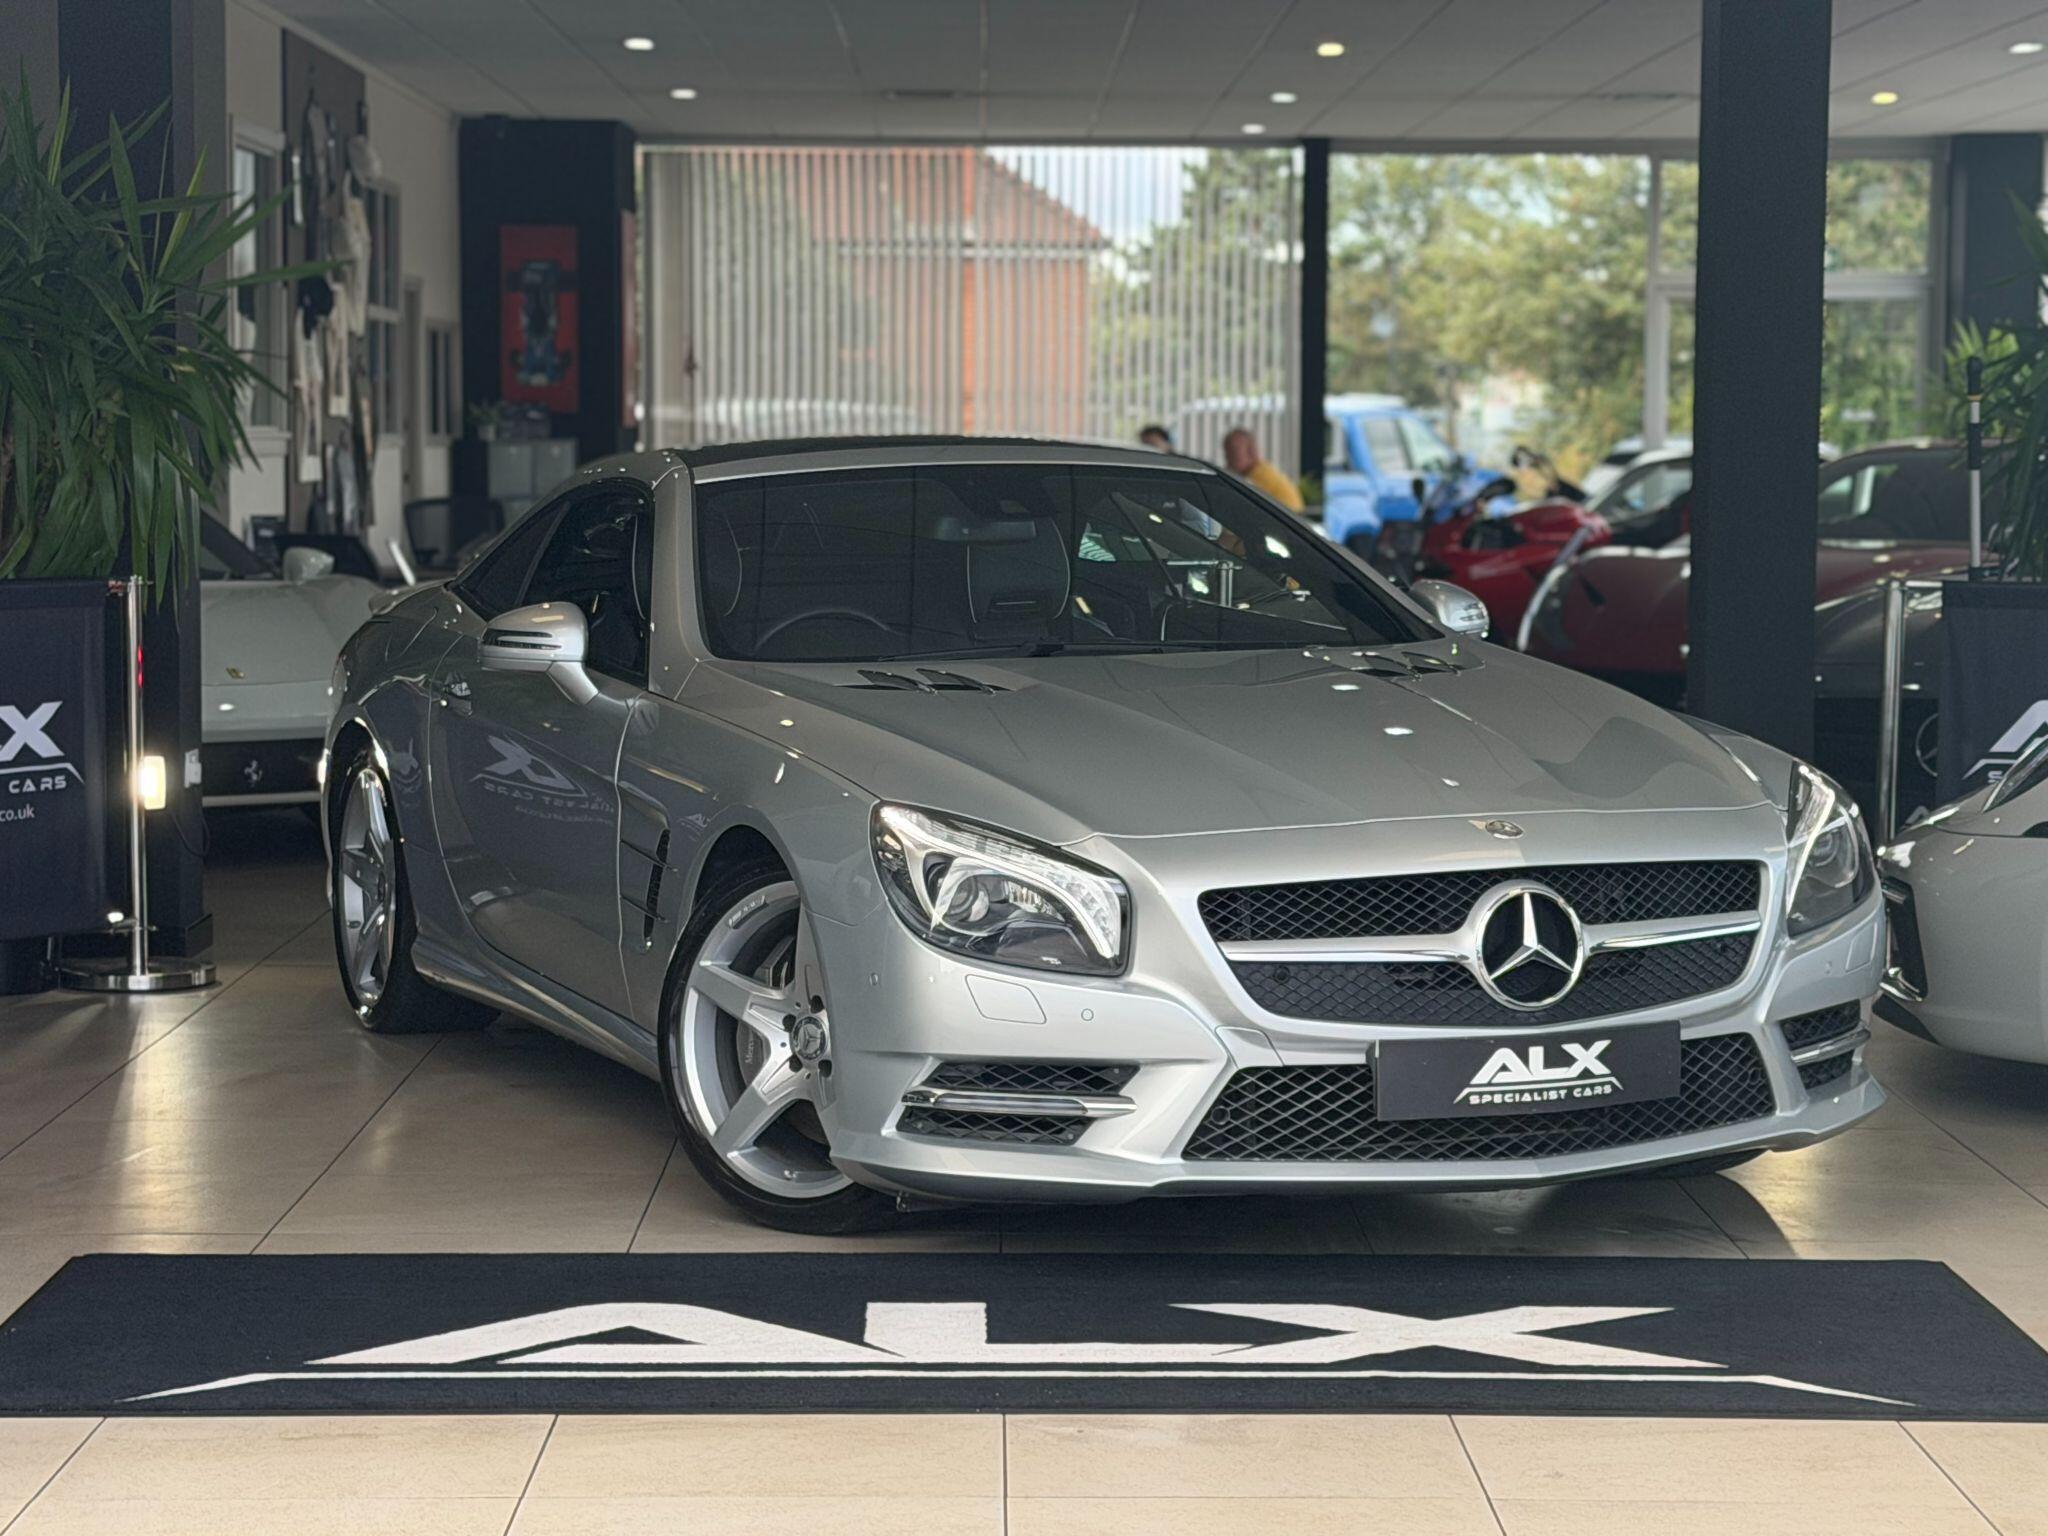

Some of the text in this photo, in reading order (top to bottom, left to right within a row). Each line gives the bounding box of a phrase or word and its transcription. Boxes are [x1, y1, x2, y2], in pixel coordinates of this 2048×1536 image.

[0, 701, 65, 762] X
[9, 776, 67, 794] CARS
[1470, 1040, 1612, 1085] ALX
[1469, 1085, 1612, 1105] SPECIALIST CARS
[304, 1302, 1728, 1367] ALX
